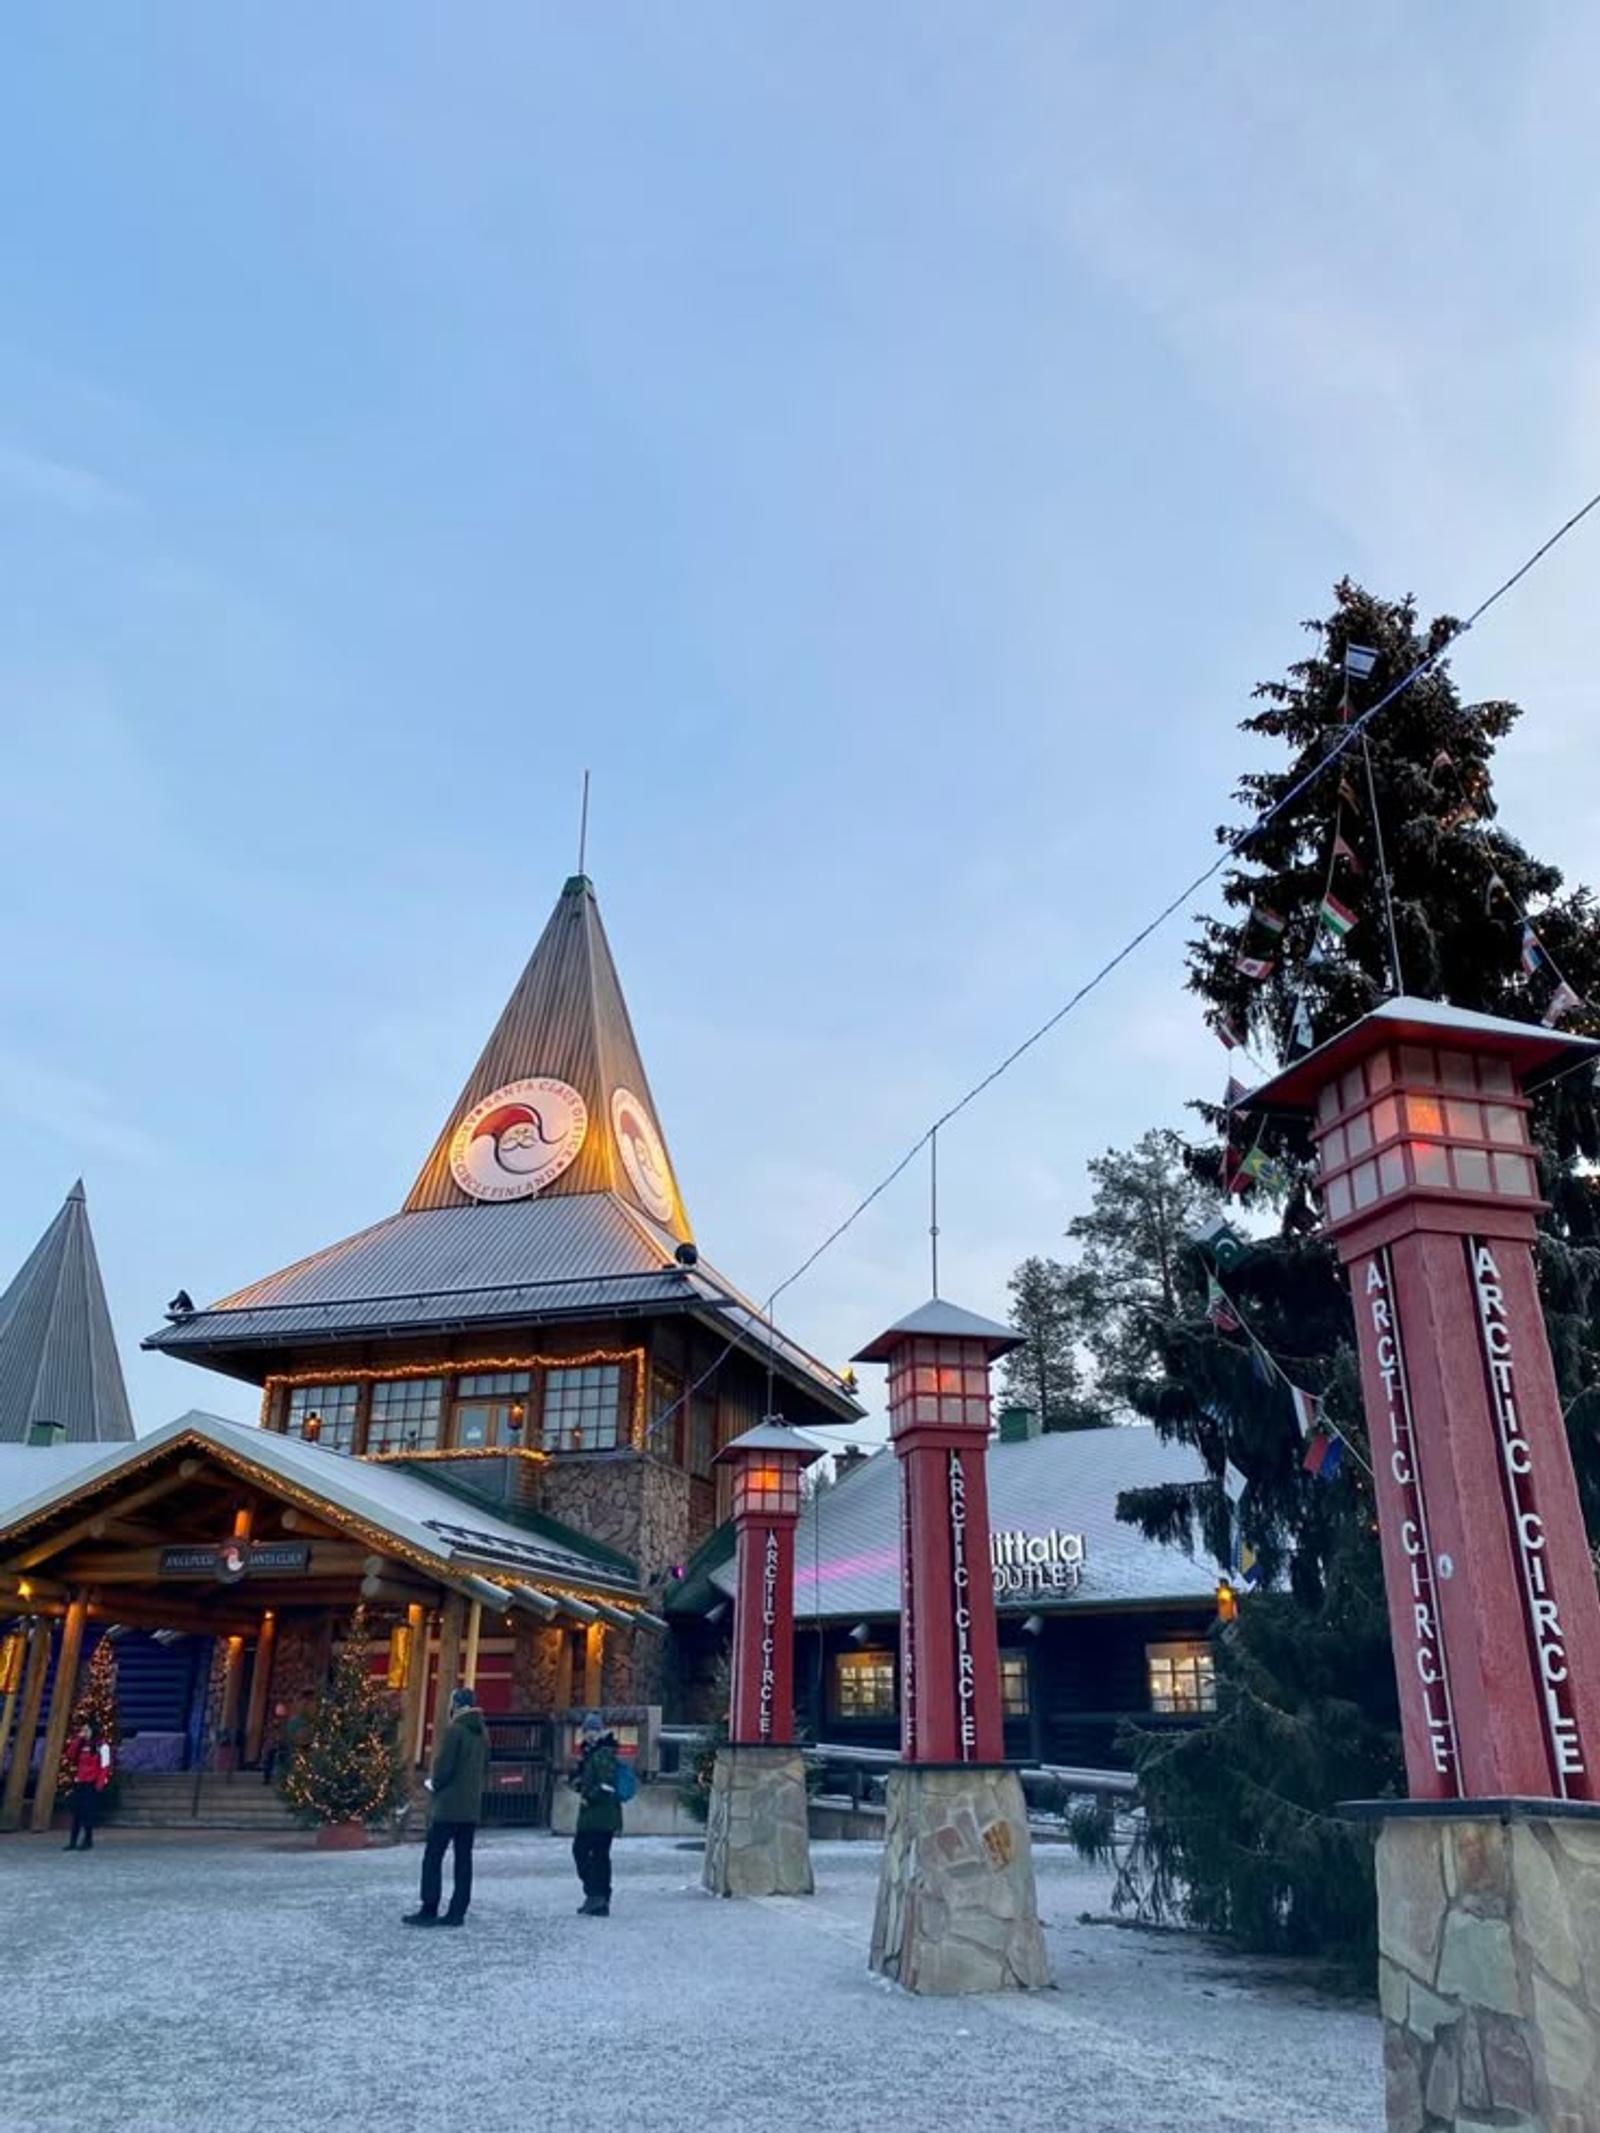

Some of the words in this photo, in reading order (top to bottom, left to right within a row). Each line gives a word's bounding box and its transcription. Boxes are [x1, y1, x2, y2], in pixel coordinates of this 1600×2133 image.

[949, 1457, 969, 1588] ARCTIC
[1367, 1261, 1410, 1485] ARCTIC
[1402, 1521, 1448, 1774] CIRCLE
[1476, 1248, 1532, 1474] ARCTIC
[1518, 1513, 1585, 1774] CIRCLE
[763, 1531, 778, 1625] ARCTIC
[991, 1563, 1081, 1592] OUTLET
[760, 1639, 774, 1733] CIRCLE
[955, 1608, 976, 1746] CIRCLE
